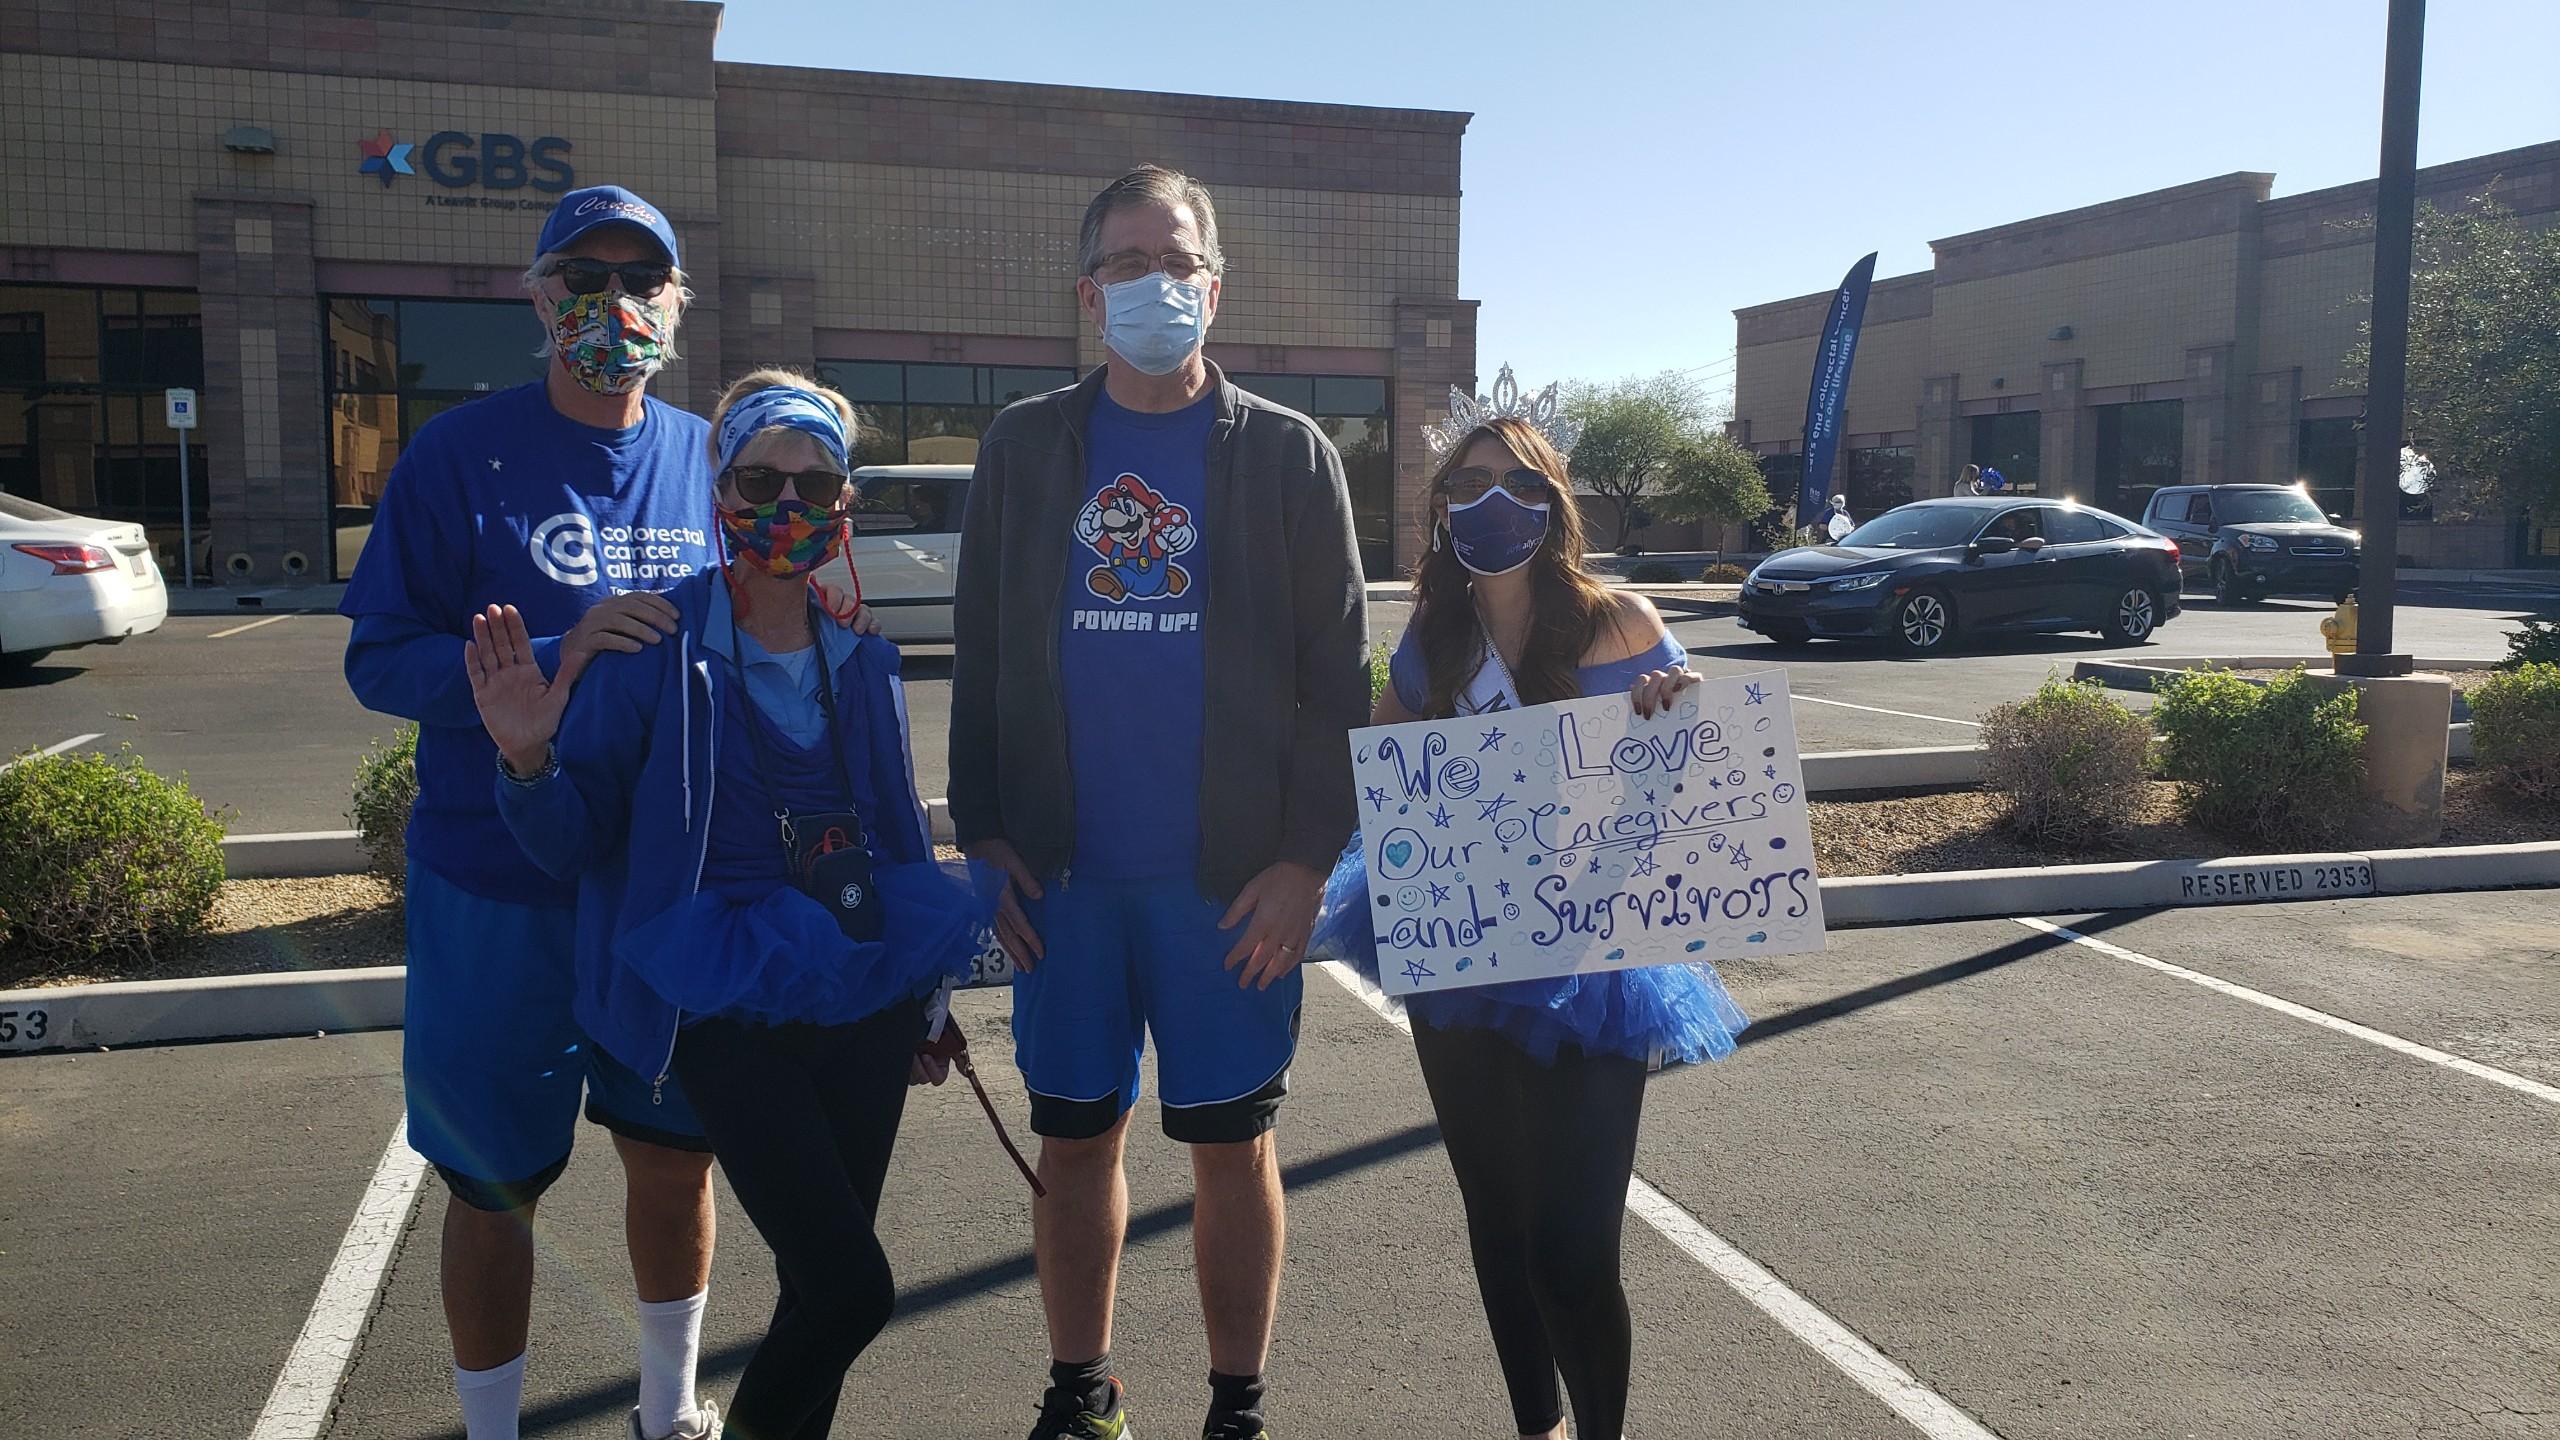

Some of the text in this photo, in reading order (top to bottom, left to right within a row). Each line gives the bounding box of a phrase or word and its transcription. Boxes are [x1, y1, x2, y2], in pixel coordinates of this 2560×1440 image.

[423, 130, 575, 193] GBS
[480, 197, 517, 212] Group
[1831, 334, 1853, 388] lifetime
[1813, 412, 1824, 439] end
[1819, 339, 1838, 410] colorectal
[1826, 389, 1838, 415] our
[600, 525, 707, 547] colorectal
[603, 544, 680, 561] cancer
[606, 562, 693, 579] alliance
[1159, 612, 1199, 632] UP!
[1378, 712, 1731, 803] We Love
[1378, 792, 1767, 880] Our Caregivers
[2181, 865, 2372, 898] RESERVED 2353
[1531, 868, 1811, 947] Survivors
[0, 1009, 48, 1042] 53
